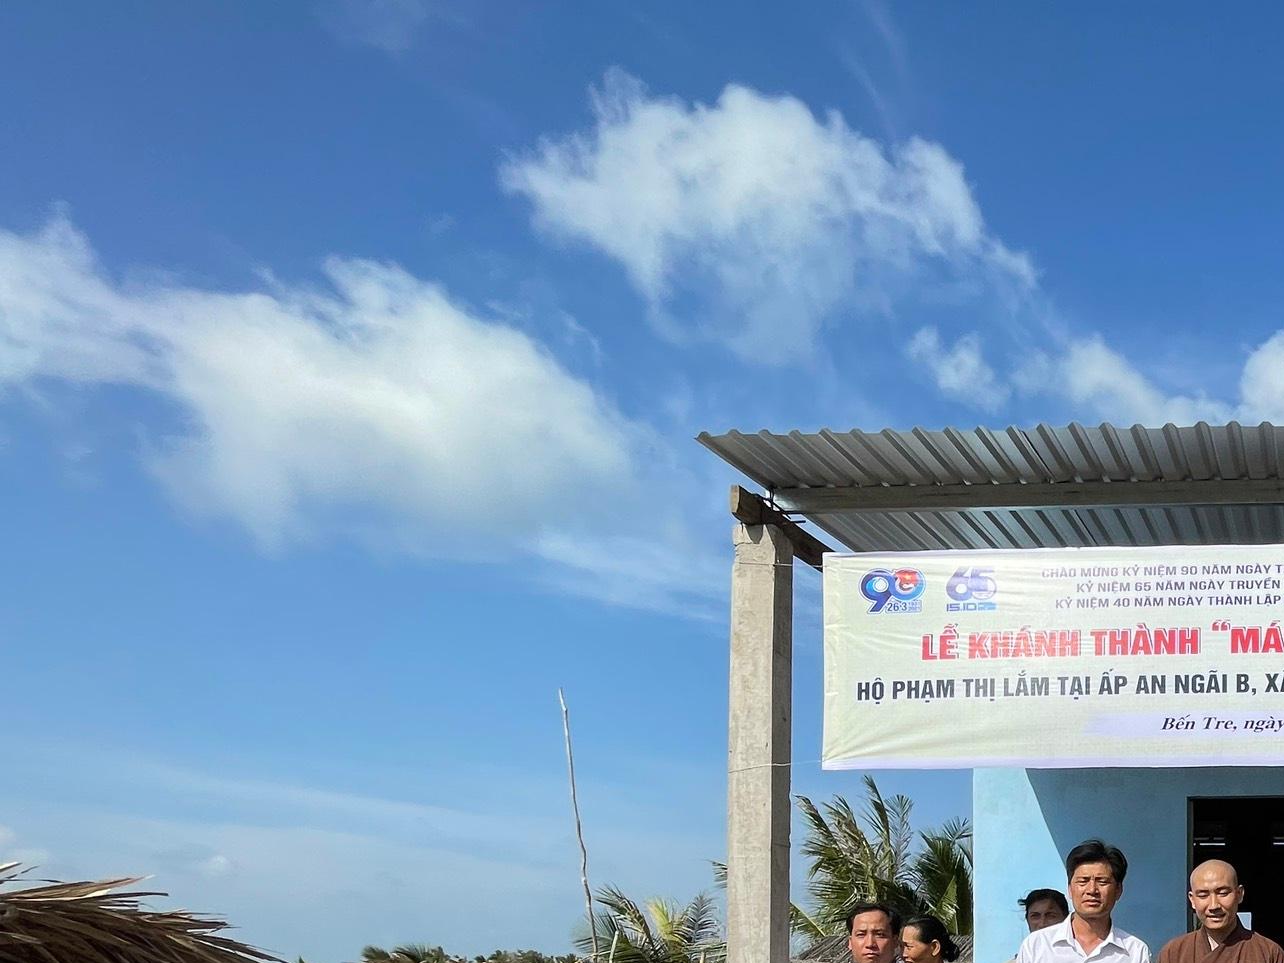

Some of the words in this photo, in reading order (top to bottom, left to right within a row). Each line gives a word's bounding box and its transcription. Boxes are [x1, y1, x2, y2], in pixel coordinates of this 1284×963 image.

[1042, 566, 1076, 578] CHÀO
[1122, 564, 1140, 576] KỶ
[1144, 564, 1176, 578] NIỆM
[1180, 566, 1198, 576] 90
[1202, 564, 1231, 575] NĂM
[1236, 562, 1271, 574] NGÀY
[1076, 580, 1094, 593] KỶ
[1098, 581, 1130, 594] NIỆM
[1134, 582, 1151, 592] 65
[1156, 580, 1185, 591] NĂM
[1190, 579, 1224, 590] NGÀY
[1055, 596, 1072, 609] KỶ
[1076, 597, 1109, 610] NIỆM
[1113, 598, 1130, 607] 40
[1134, 596, 1164, 607] NĂM
[1168, 595, 1203, 606] NGÀY
[1208, 594, 1252, 605] THÀNH
[1256, 594, 1281, 606] LẬP
[922, 623, 959, 660] LỄ
[968, 624, 1082, 659] KHÁNH
[1090, 622, 1201, 656] THÀNH
[857, 678, 884, 704] HỘ
[892, 679, 955, 703] PHẠM
[962, 678, 995, 701] THỊ
[1003, 670, 1049, 696] LẮM
[1057, 676, 1091, 700] TẠI
[1098, 668, 1128, 694] ẤP
[1136, 674, 1166, 694] AN
[1174, 670, 1227, 694] NGÃI
[1236, 674, 1256, 696] B,
[1161, 714, 1195, 730] Bến
[1202, 716, 1237, 732] Tre,
